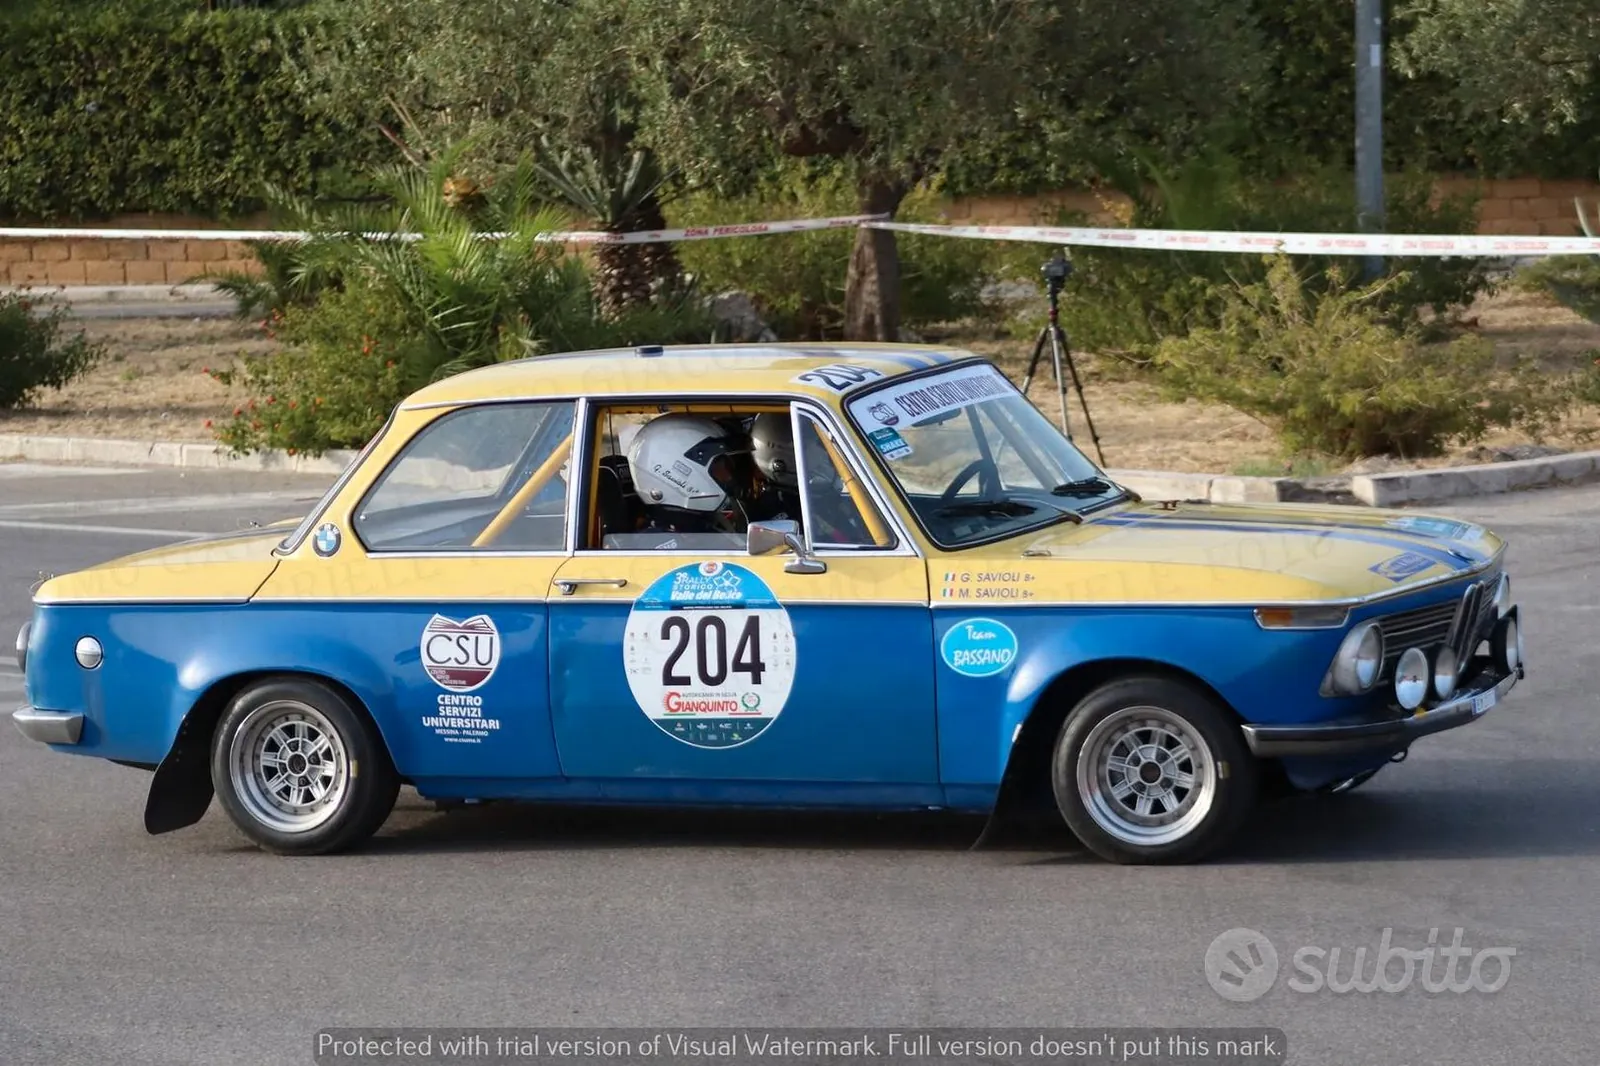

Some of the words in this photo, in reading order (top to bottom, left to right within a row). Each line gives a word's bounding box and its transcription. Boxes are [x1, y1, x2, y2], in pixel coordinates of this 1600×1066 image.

[798, 364, 882, 391] 204
[894, 388, 940, 417] CENTRO
[872, 403, 895, 422] CSU
[960, 572, 973, 583] G.
[976, 572, 1021, 582] SAVIOLI
[958, 588, 972, 598] M.
[975, 588, 1019, 599] SAVIOLI
[965, 624, 997, 641] Team
[426, 633, 494, 666] CSU
[660, 615, 766, 687] 204
[952, 648, 1012, 667] BASSANO
[437, 694, 483, 706] CENTRO
[663, 691, 738, 713] GIANQUINTO
[438, 705, 482, 718] SERVIZI
[422, 716, 500, 730] UNIVERSITARI
